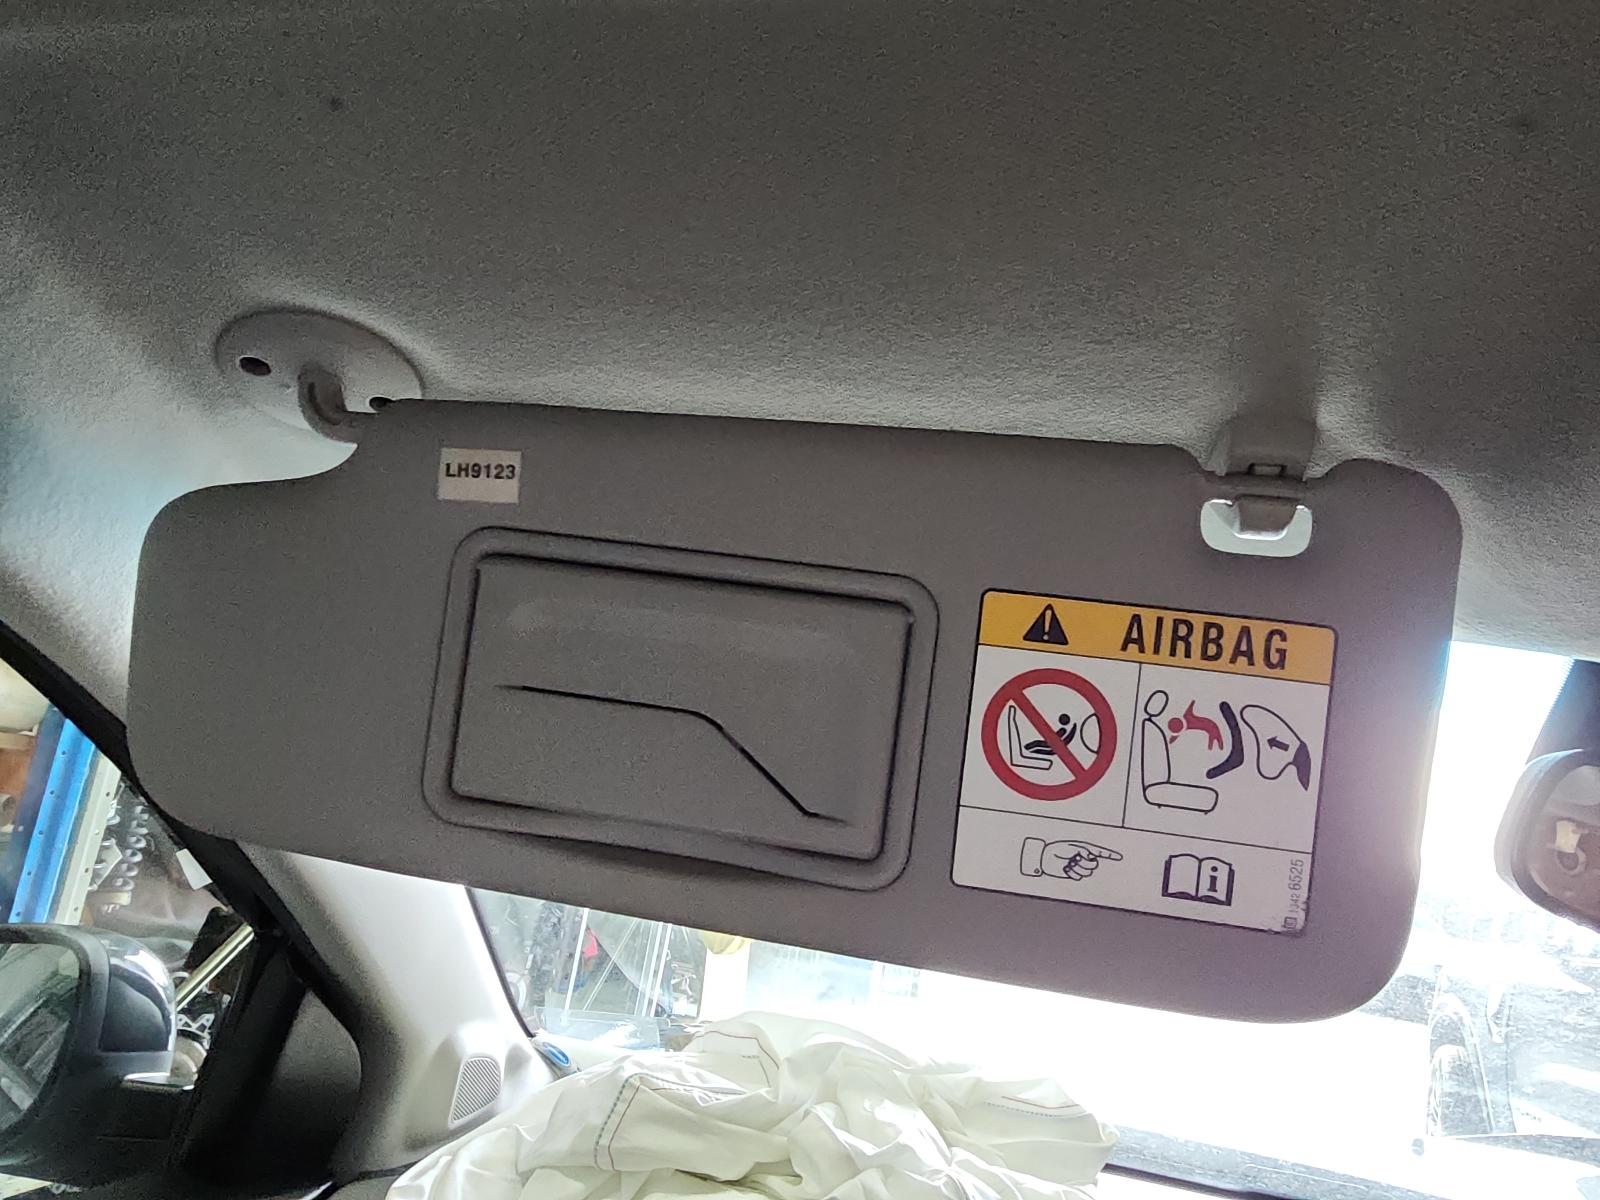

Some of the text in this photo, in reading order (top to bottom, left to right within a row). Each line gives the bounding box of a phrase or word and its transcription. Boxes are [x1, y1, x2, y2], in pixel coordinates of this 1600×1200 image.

[445, 462, 517, 480] LH9123
[1120, 613, 1288, 671] AIRBAG
[1288, 859, 1304, 891] 6525
